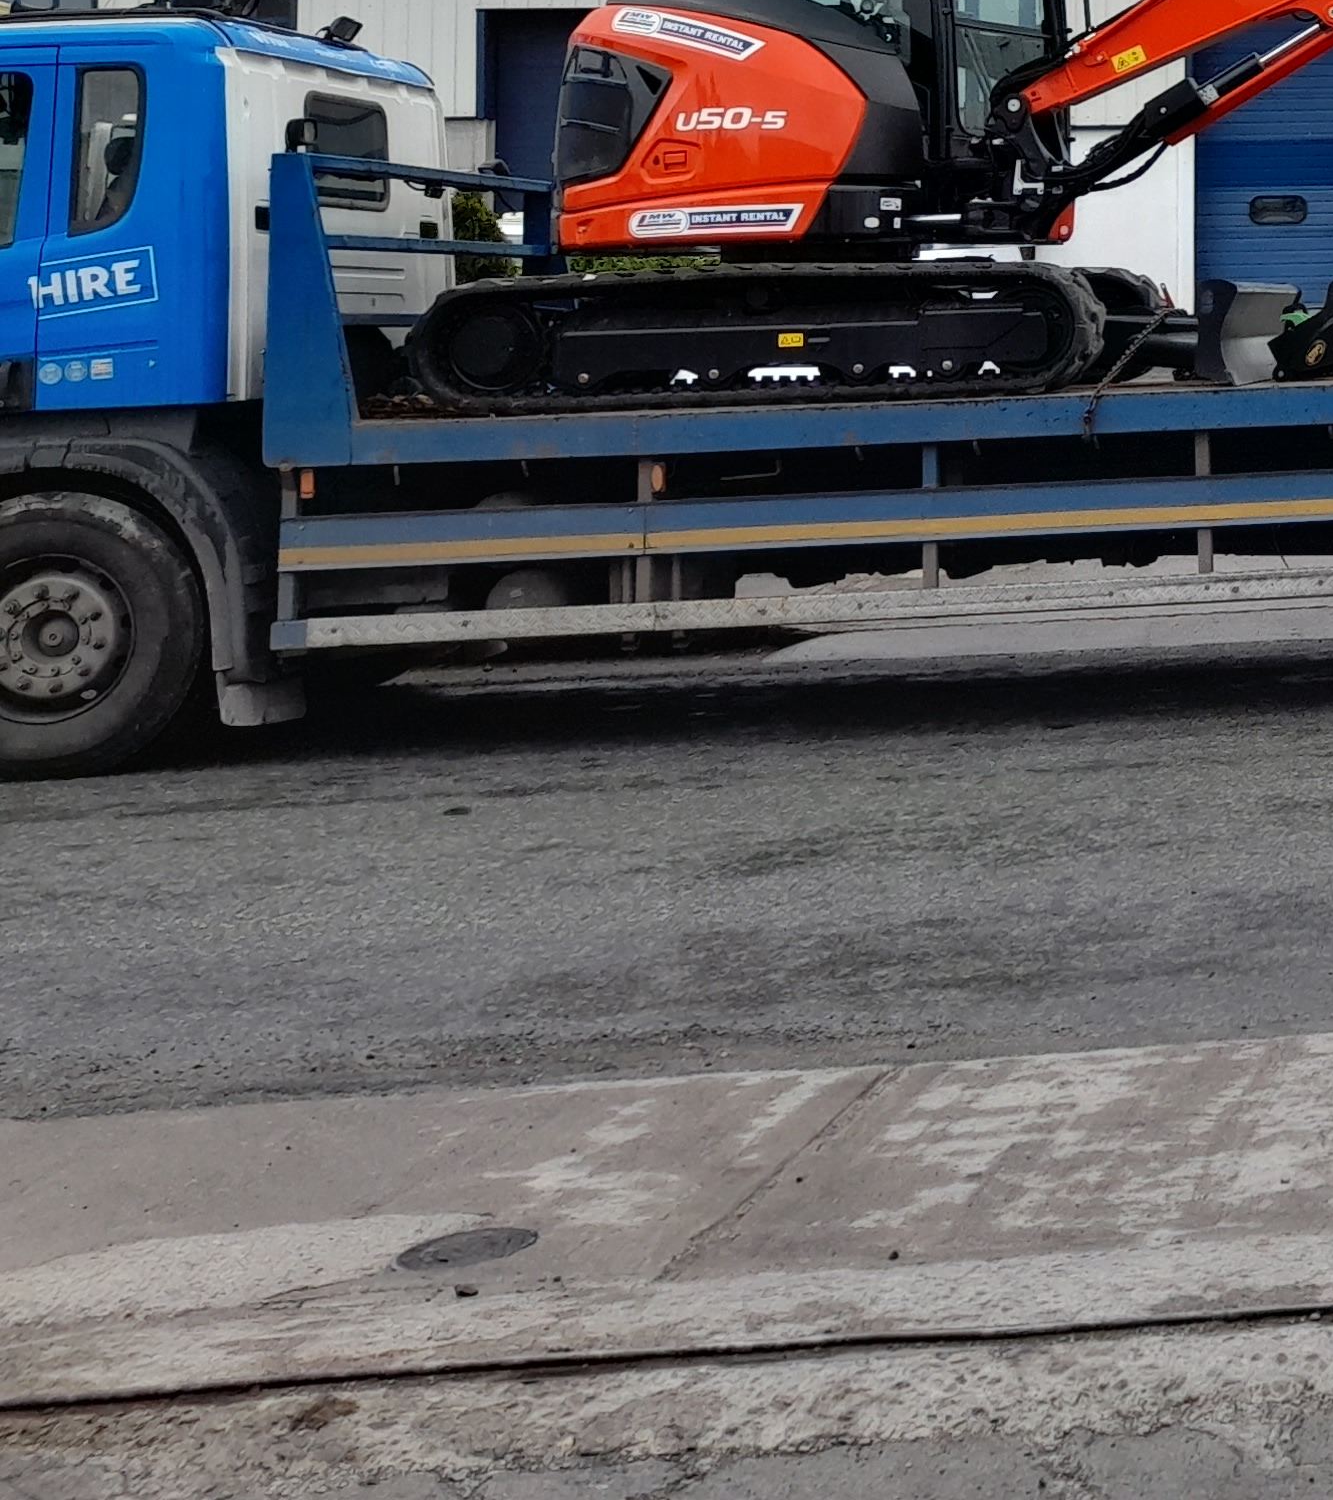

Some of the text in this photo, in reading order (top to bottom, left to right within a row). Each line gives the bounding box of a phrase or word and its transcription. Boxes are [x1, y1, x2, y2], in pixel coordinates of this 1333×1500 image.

[662, 20, 705, 37] INSTANT
[704, 32, 745, 50] RENTAL
[675, 106, 788, 132] U50-5
[691, 211, 787, 224] INSTANT RENTAL
[27, 258, 142, 310] HIRE
